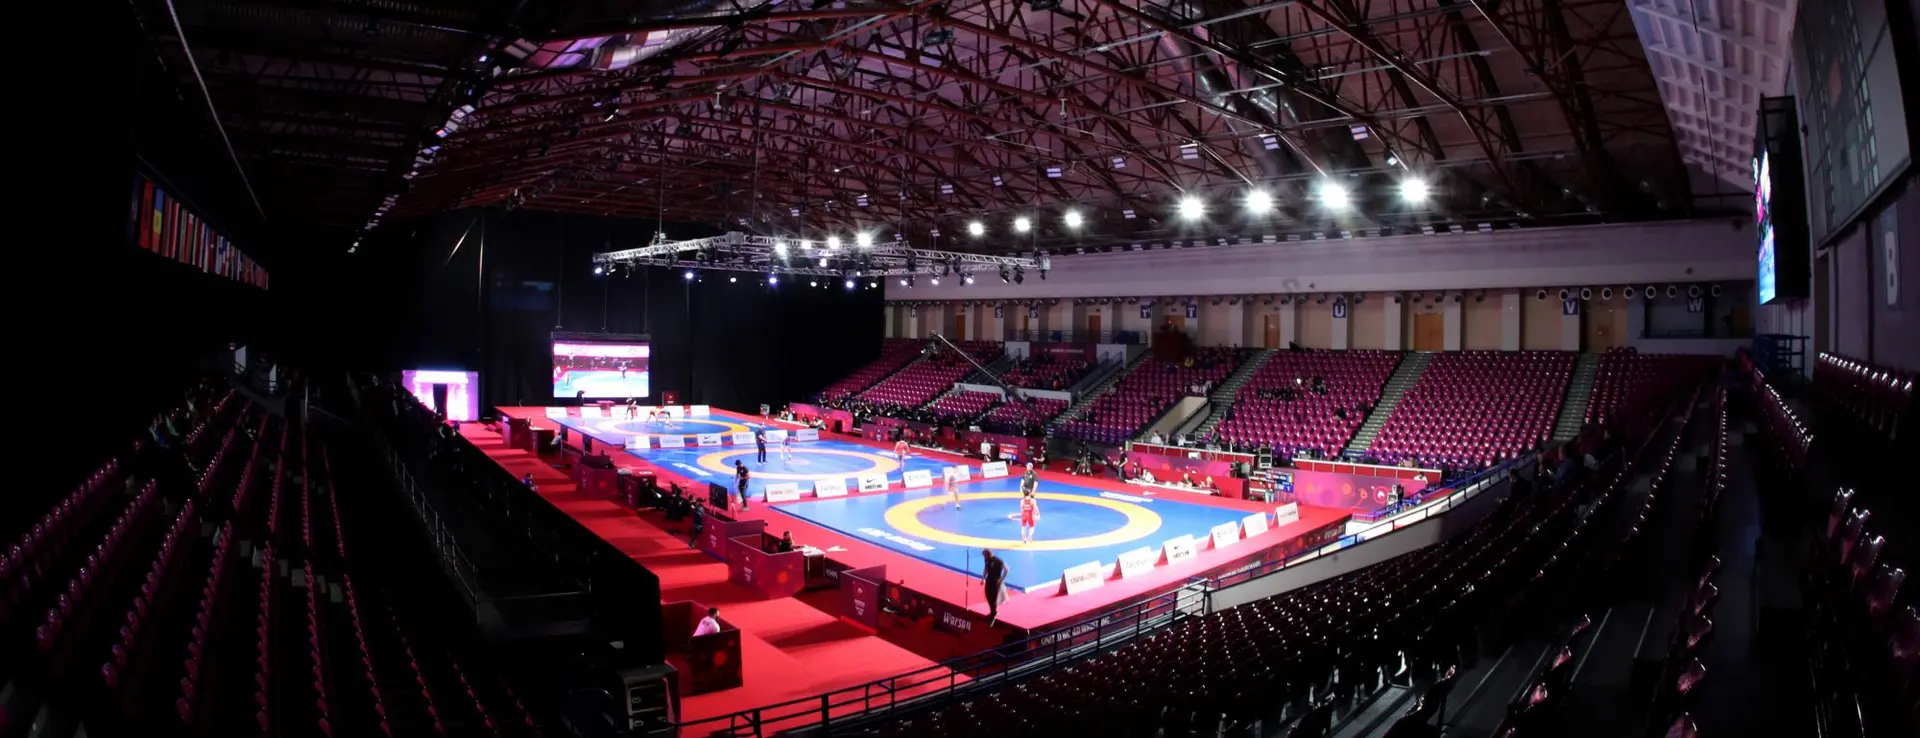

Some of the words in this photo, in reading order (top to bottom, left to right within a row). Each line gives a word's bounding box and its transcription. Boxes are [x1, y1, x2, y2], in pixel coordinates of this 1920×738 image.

[1334, 305, 1345, 317] U
[1565, 302, 1576, 315] V
[1688, 298, 1702, 312] W
[1041, 632, 1062, 646] UNITD
[1082, 616, 1111, 634] WRESTING
